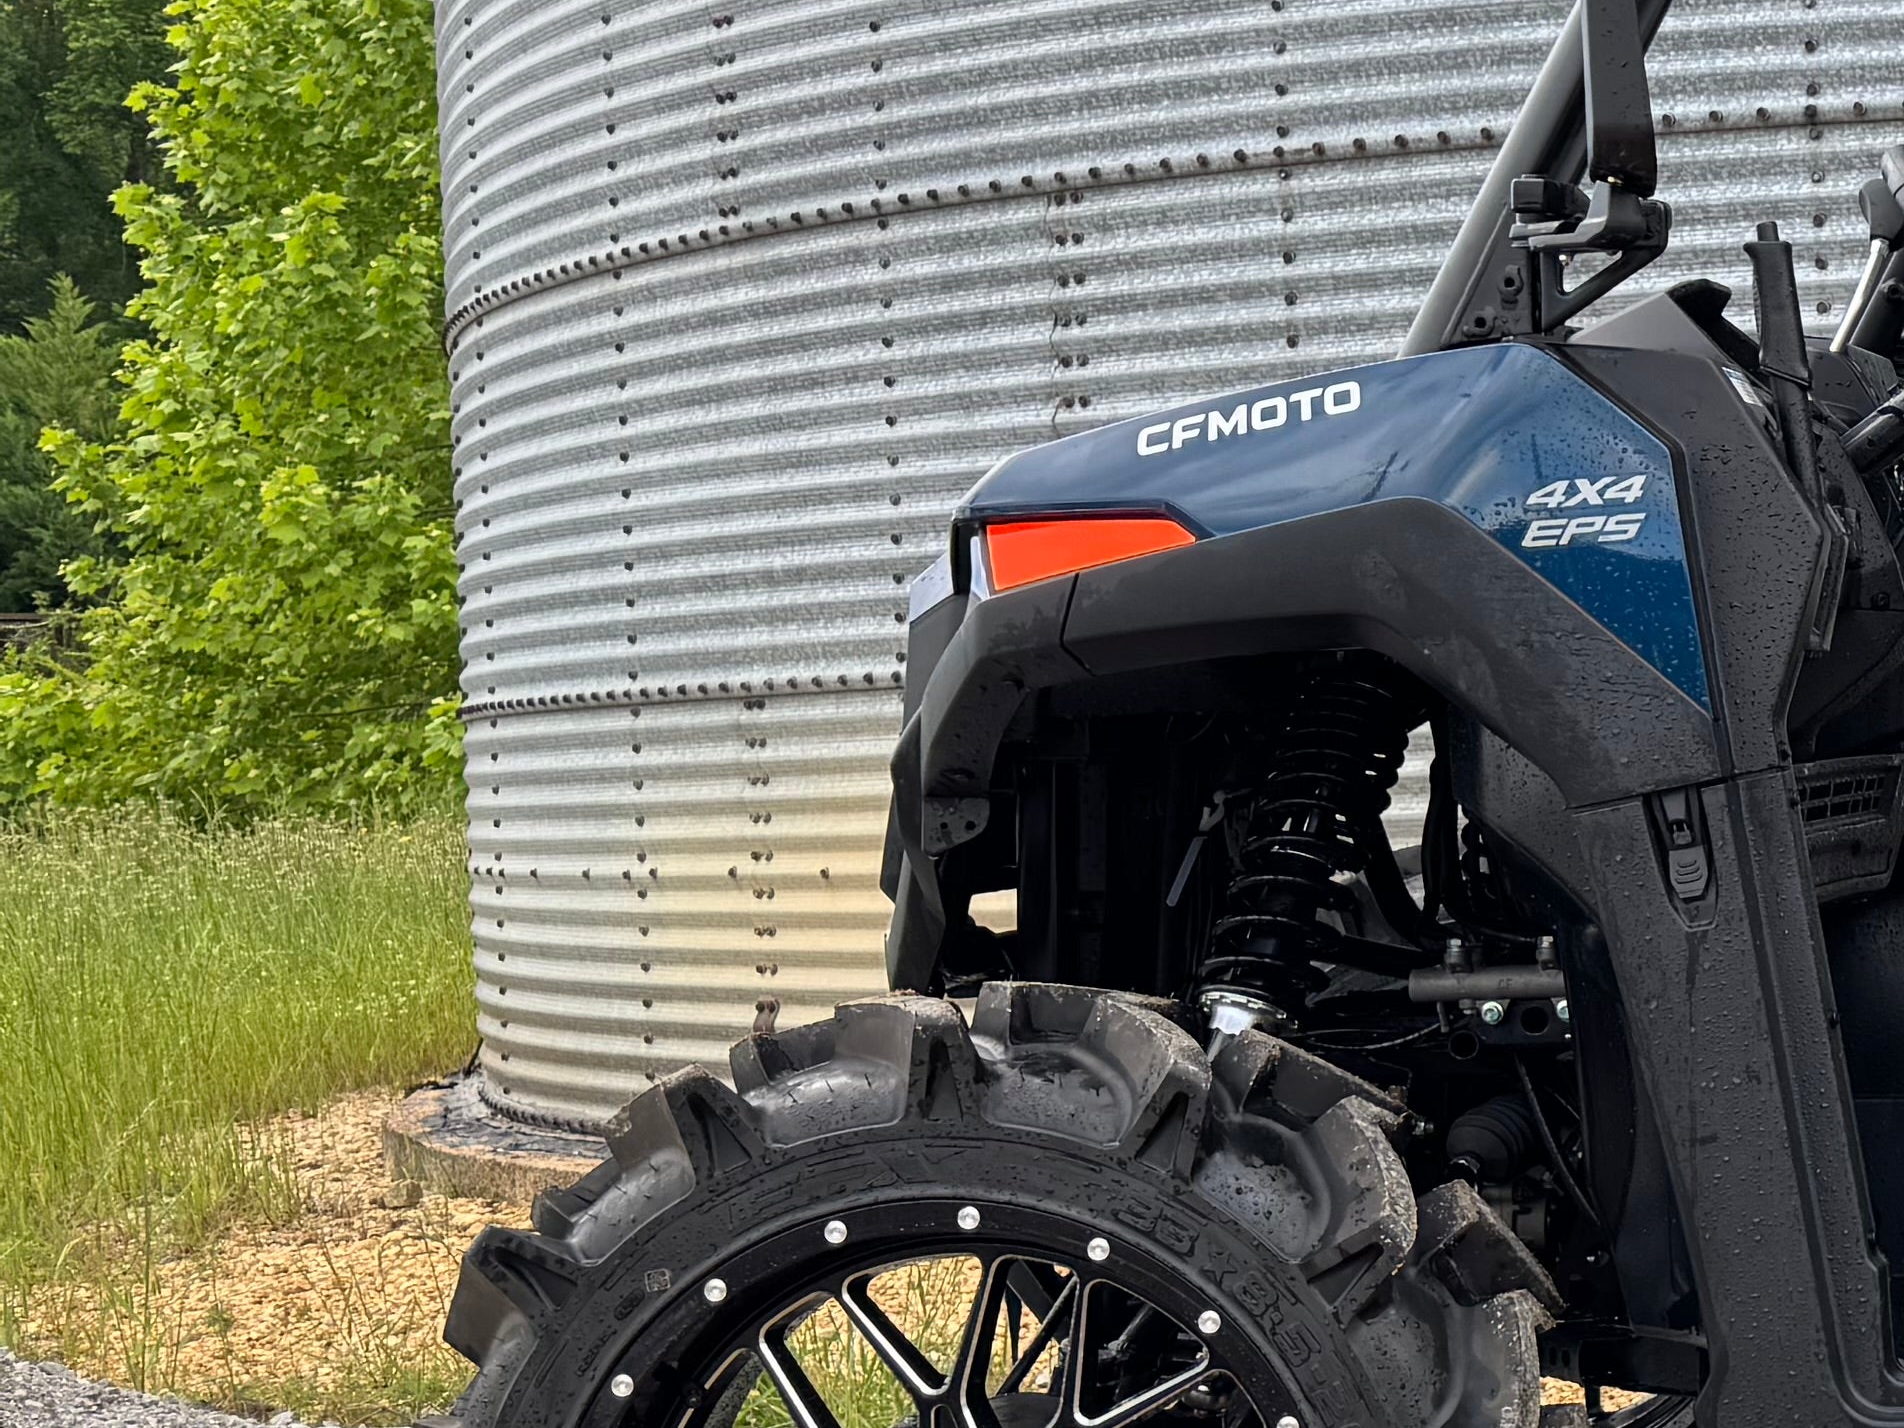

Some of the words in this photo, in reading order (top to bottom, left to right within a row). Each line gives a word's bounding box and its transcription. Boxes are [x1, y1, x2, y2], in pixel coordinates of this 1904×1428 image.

[1137, 381, 1361, 456] CFMOTO
[1526, 474, 1647, 508] 4X4
[1521, 513, 1647, 547] EPS
